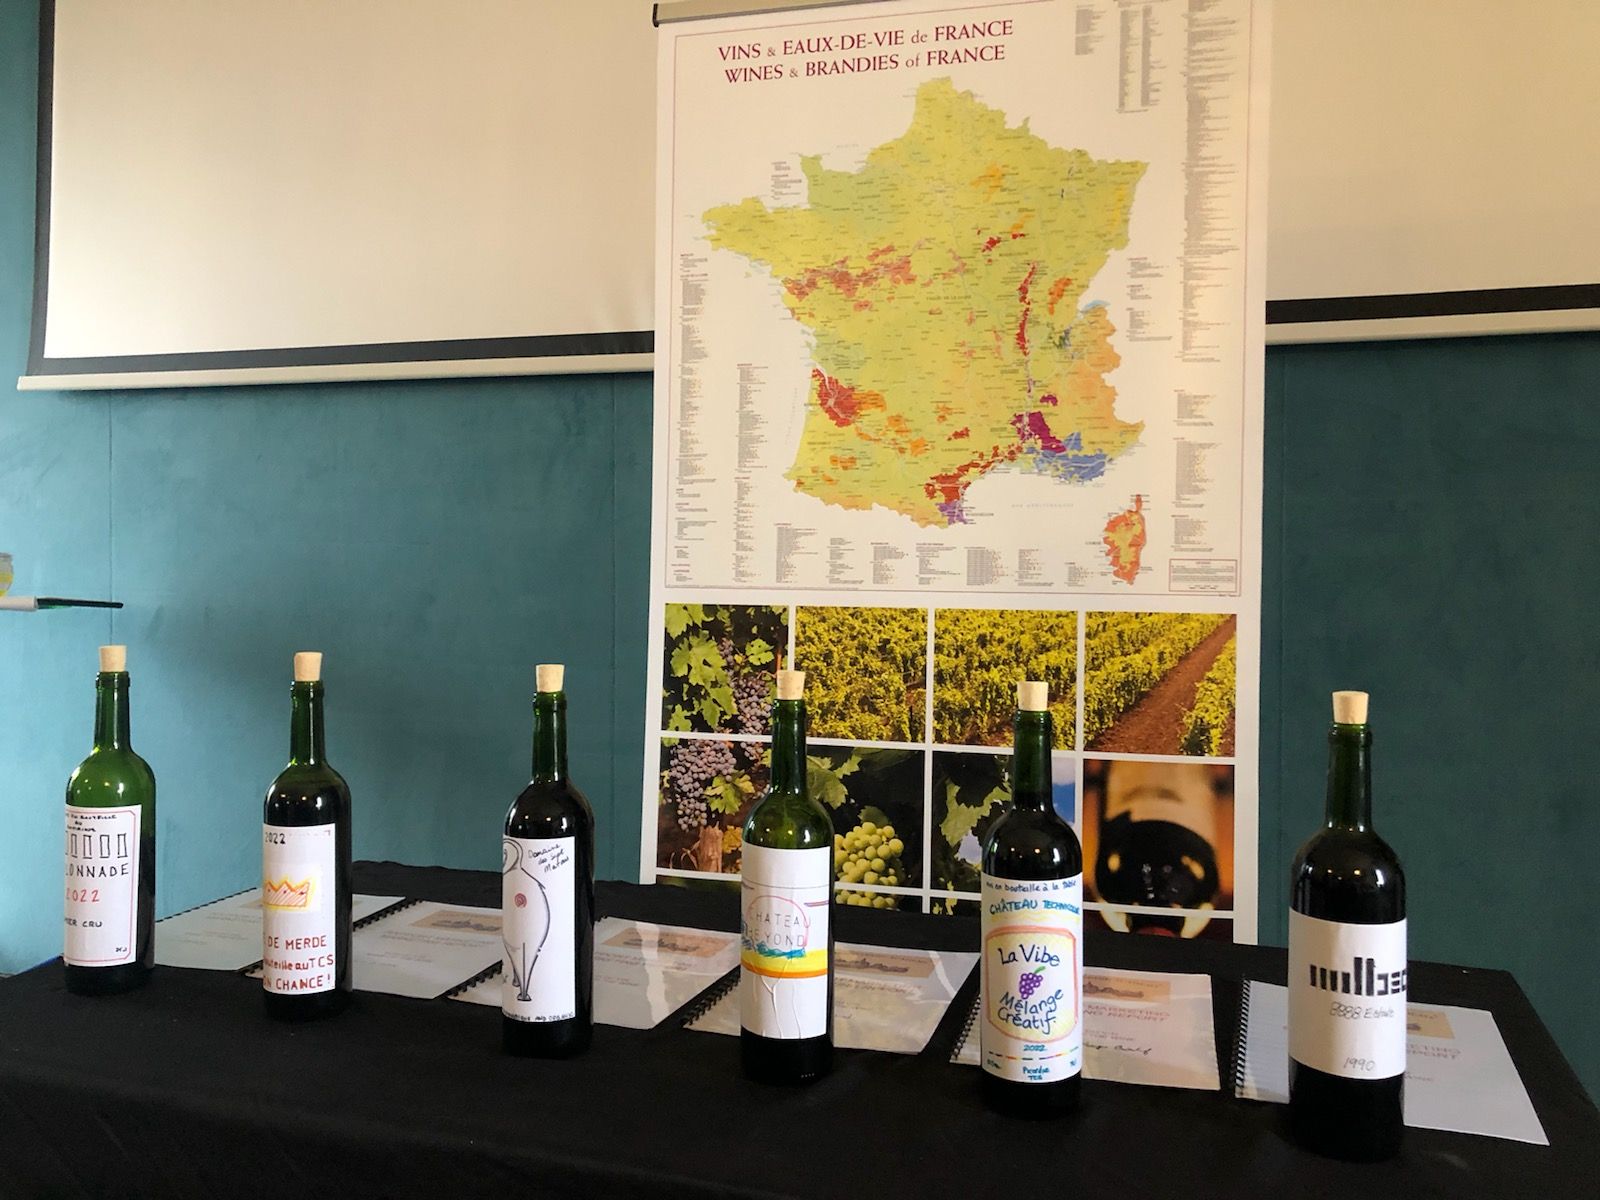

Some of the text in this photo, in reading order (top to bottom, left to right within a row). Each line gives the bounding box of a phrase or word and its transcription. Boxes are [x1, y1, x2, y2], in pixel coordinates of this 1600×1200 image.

[718, 20, 1014, 61] VINS & EAUX-DE-VIE de FRANCE
[724, 44, 1005, 84] WINES & BRANDIES of FRANCE
[264, 831, 286, 845] 2022
[82, 920, 103, 928] CRU
[267, 935, 279, 949] DE
[285, 935, 327, 950] MERDE
[997, 944, 1060, 967] La Vibe
[1000, 989, 1064, 1014] Mélange
[1343, 1057, 1375, 1071] 1990
